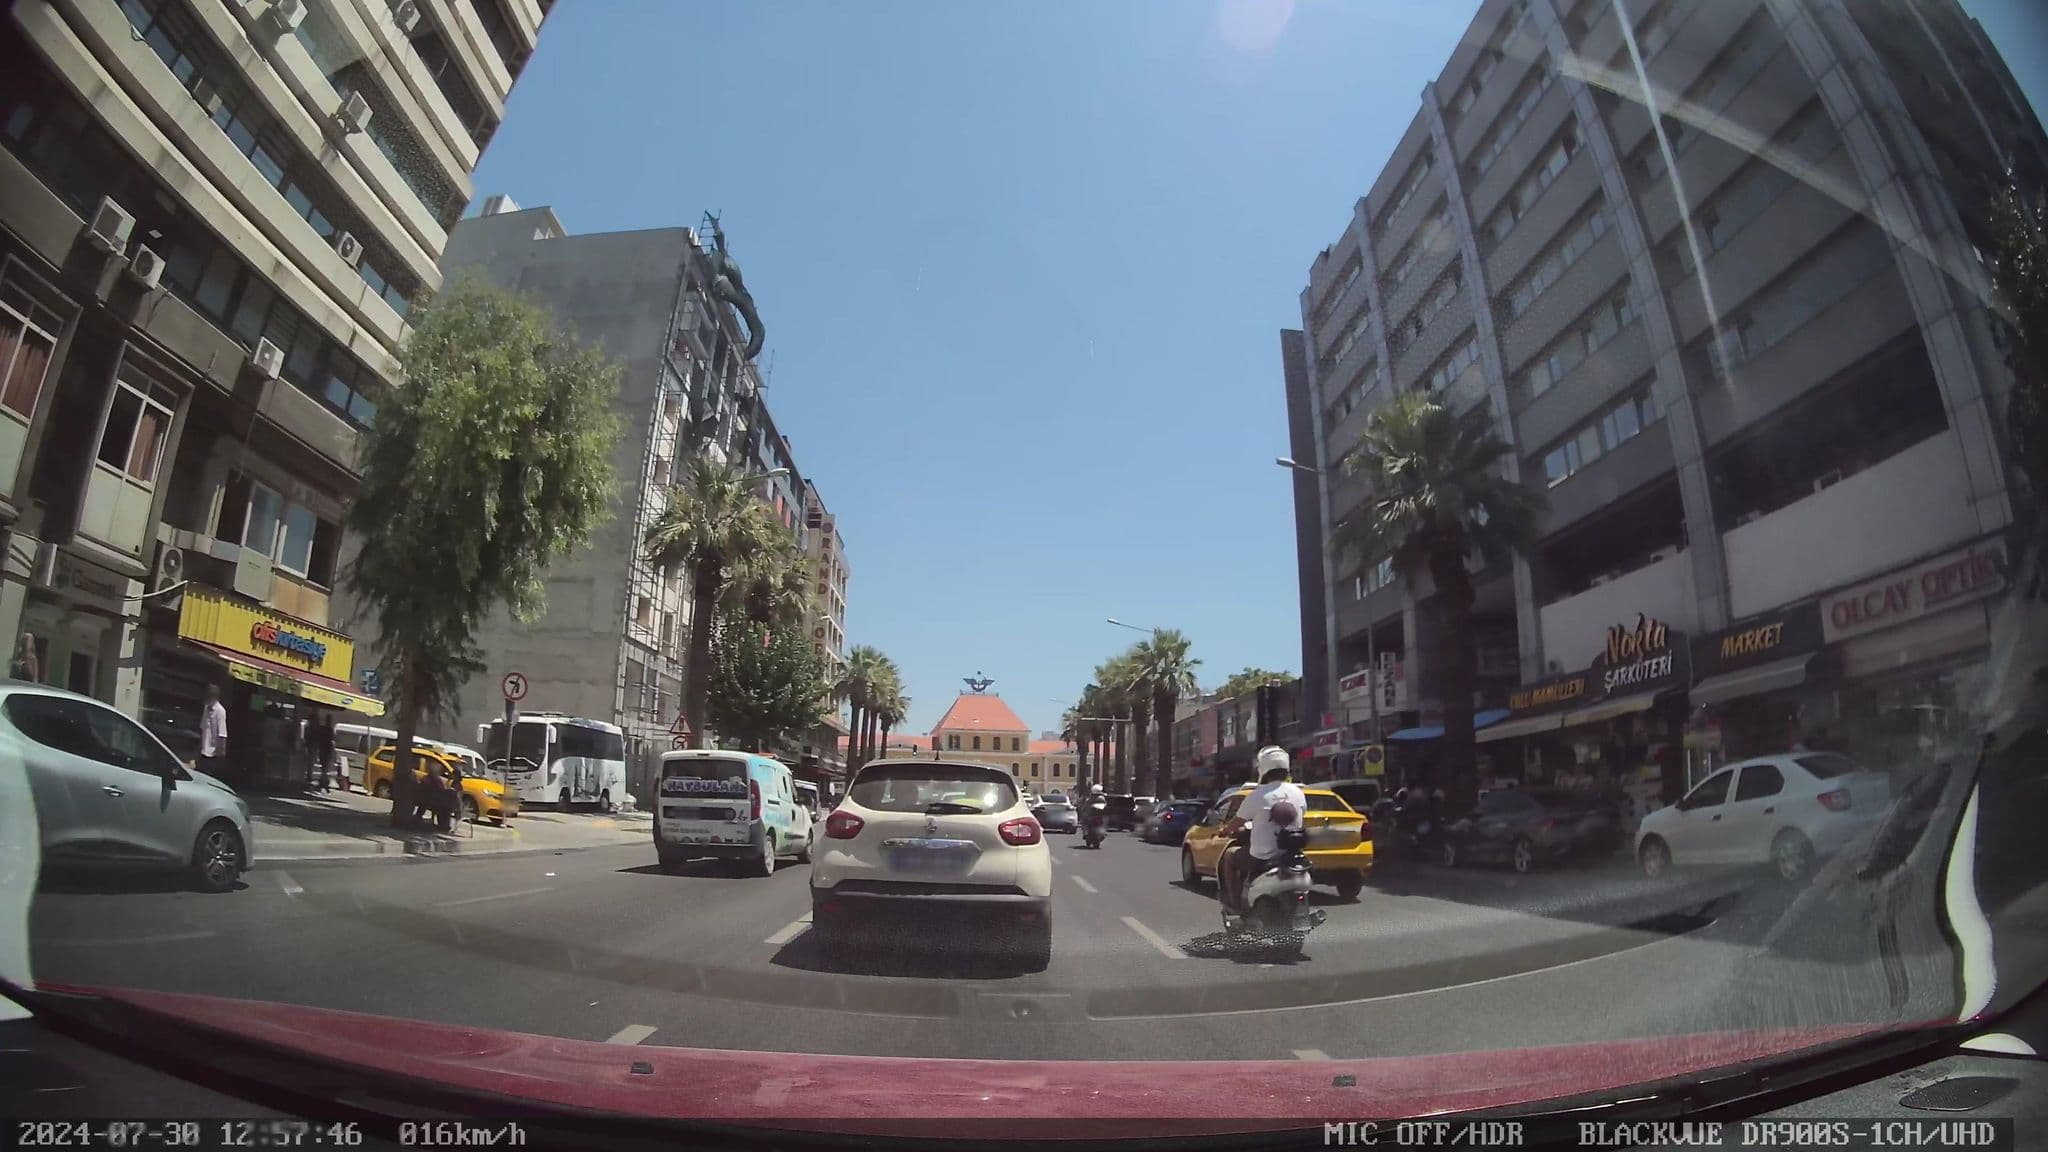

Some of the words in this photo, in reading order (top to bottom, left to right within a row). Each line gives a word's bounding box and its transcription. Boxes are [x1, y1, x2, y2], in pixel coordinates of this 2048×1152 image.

[1830, 578, 1913, 632] OLCAY
[1607, 611, 1668, 665] Nokta
[1720, 622, 1784, 660] MARKET
